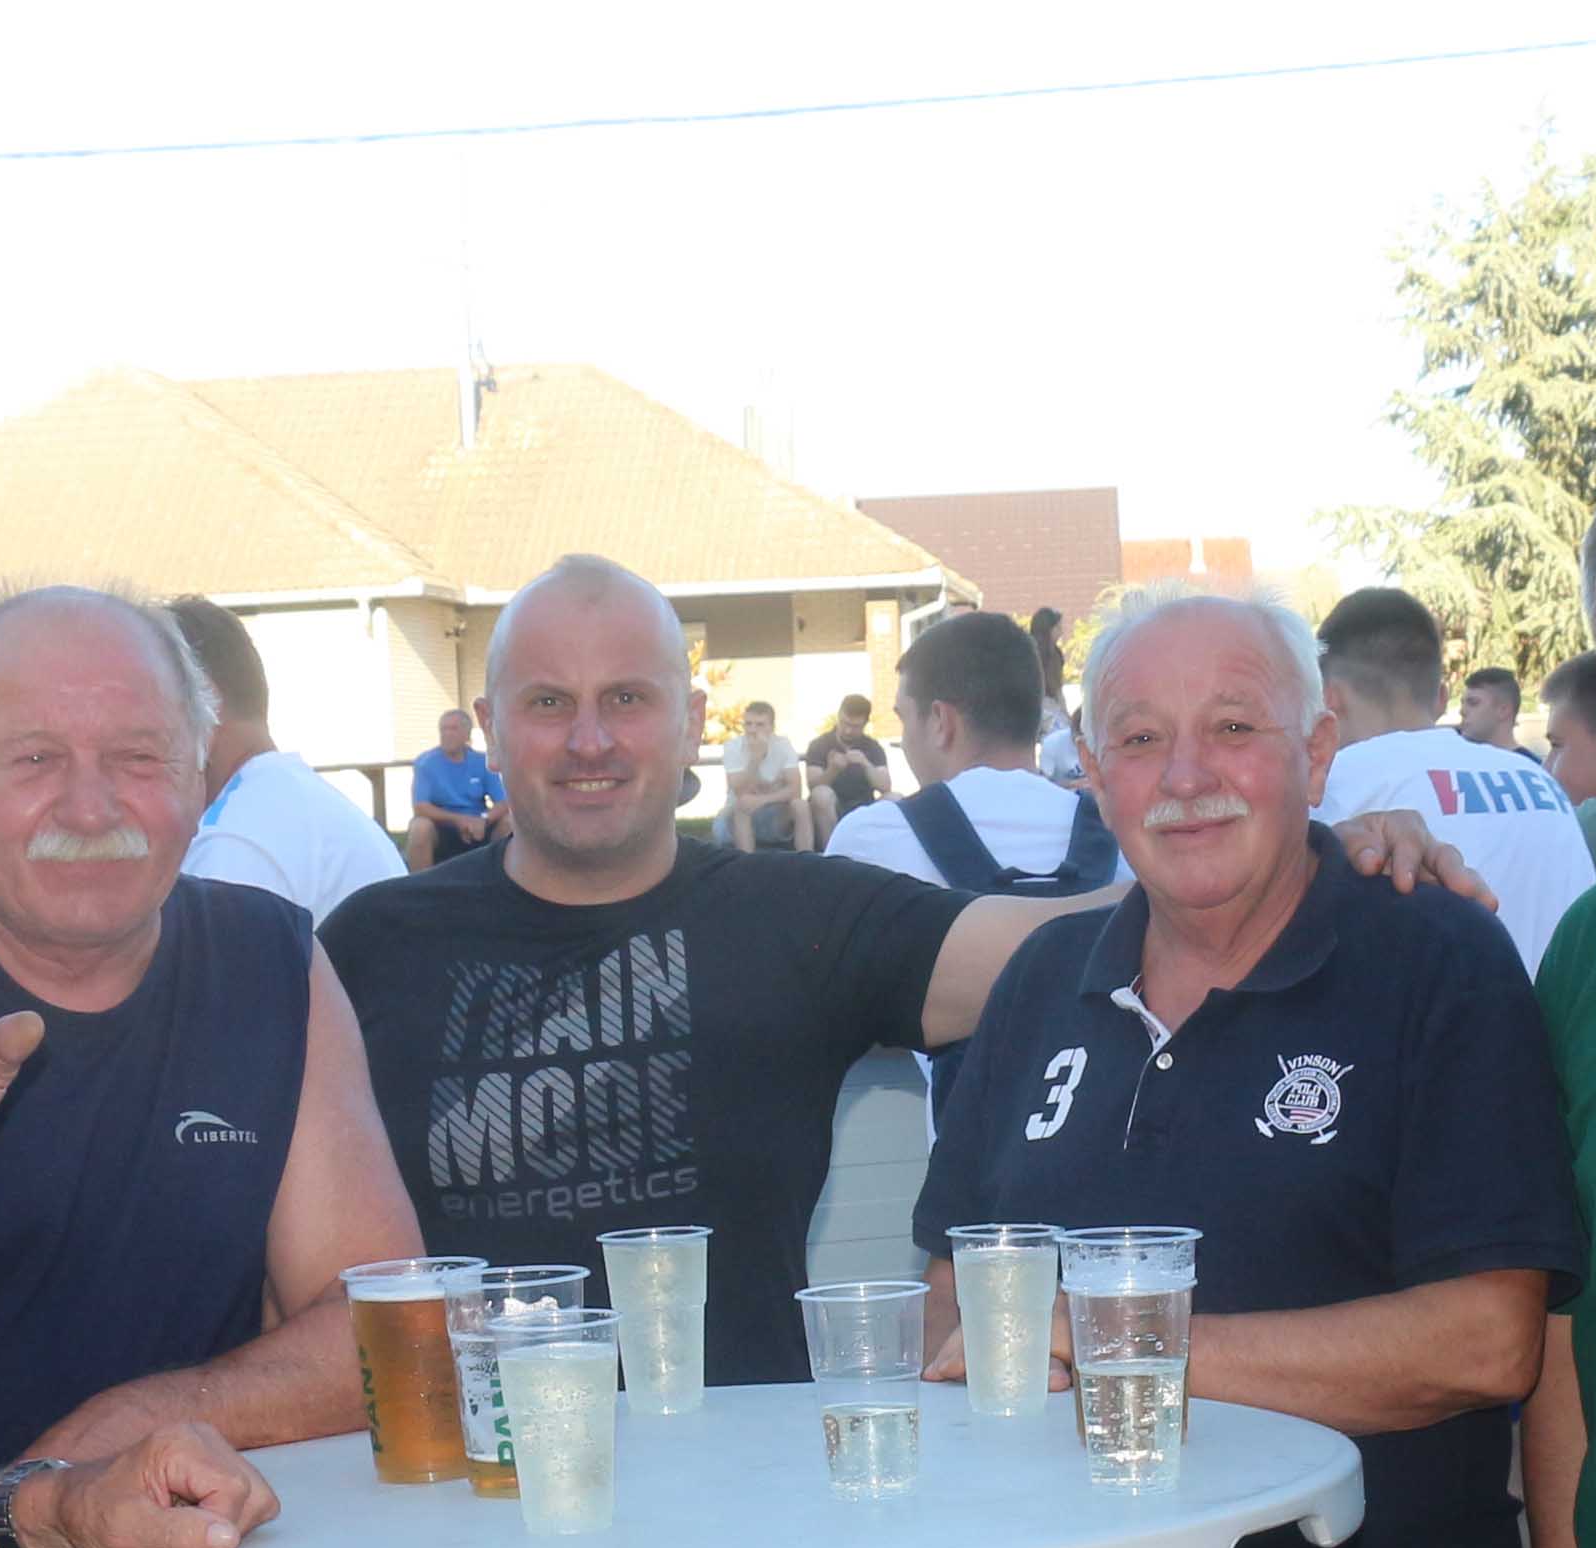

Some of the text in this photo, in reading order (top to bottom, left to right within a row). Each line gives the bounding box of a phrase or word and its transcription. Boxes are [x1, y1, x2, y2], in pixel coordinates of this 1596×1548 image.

[441, 928, 692, 1062] TRAIN
[1287, 1054, 1342, 1076] VINSON
[1025, 1046, 1088, 1141] 3
[1285, 1094, 1320, 1108] CLUB
[1290, 1082, 1323, 1097] POLO
[193, 1129, 259, 1144] LIBERTEL
[428, 1049, 694, 1188] MODE
[441, 1167, 699, 1222] energetics
